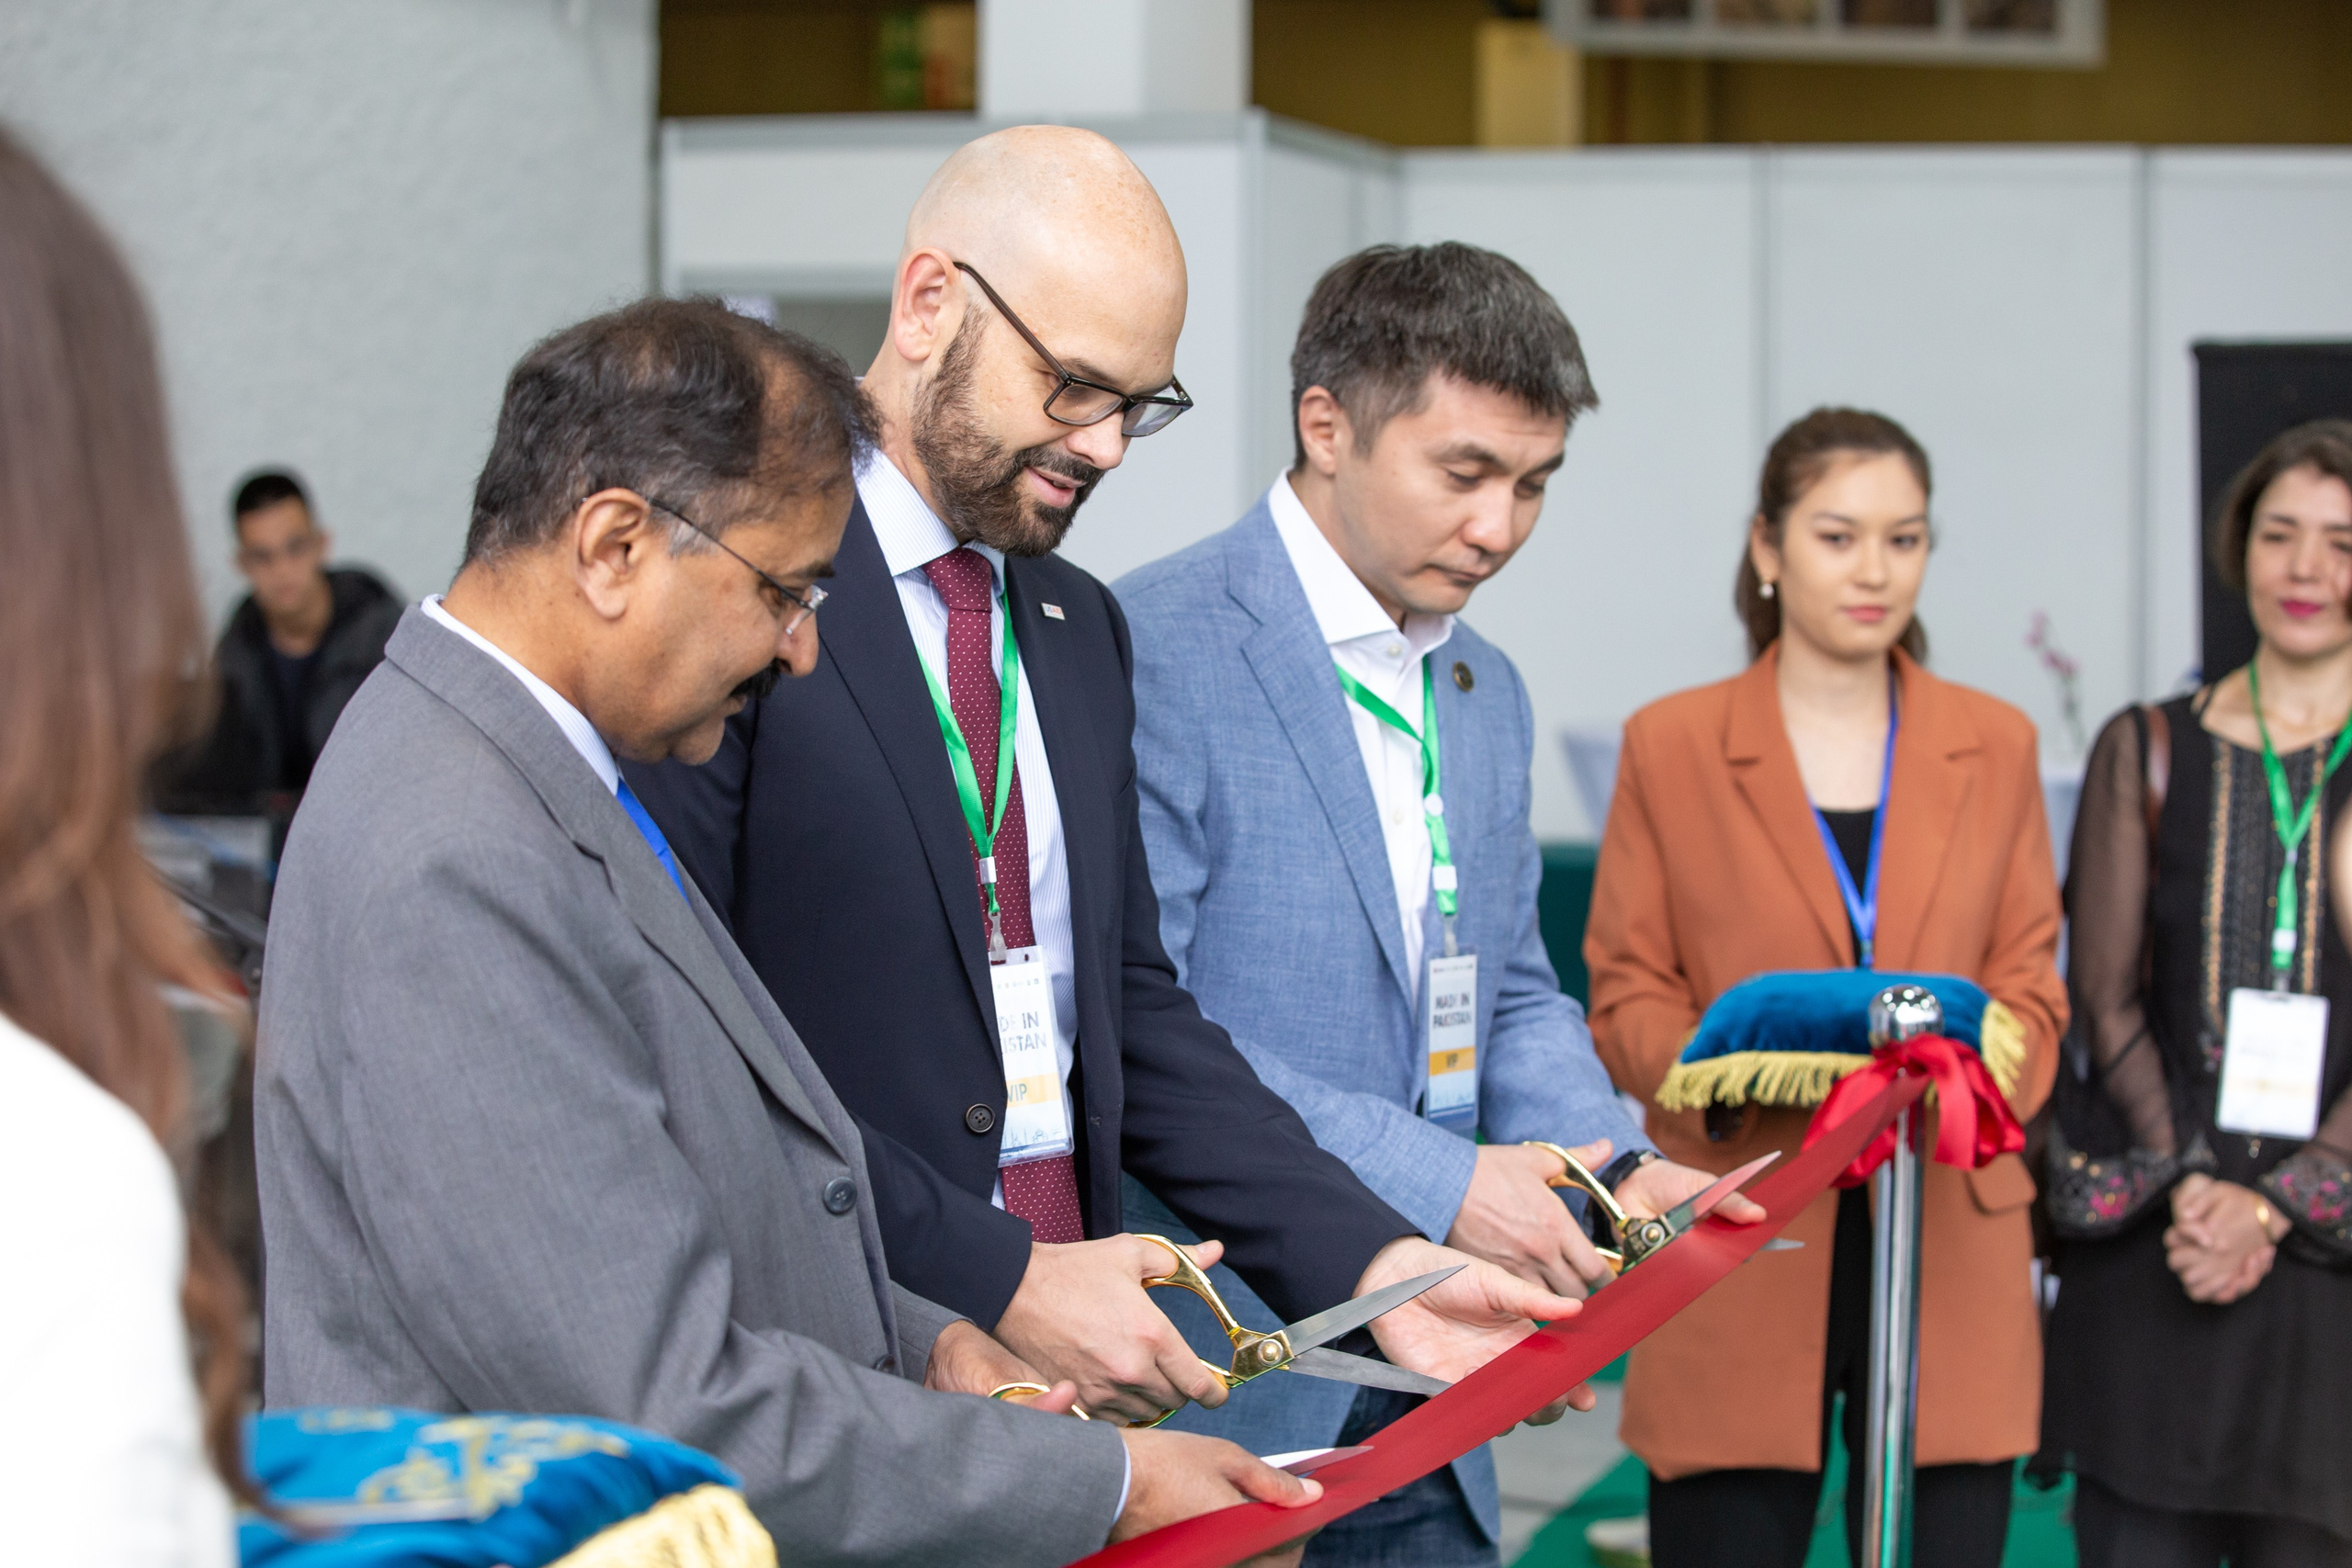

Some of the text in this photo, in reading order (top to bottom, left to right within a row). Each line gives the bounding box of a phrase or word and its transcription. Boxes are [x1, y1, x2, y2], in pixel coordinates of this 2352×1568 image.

[1461, 993, 1470, 1006] IN
[998, 1011, 1039, 1032] DE IN
[1433, 1012, 1472, 1027] PAKISTAN
[1003, 1032, 1047, 1055] ISTAN
[1447, 1053, 1458, 1067] VIP
[1008, 1083, 1027, 1102] VIP
